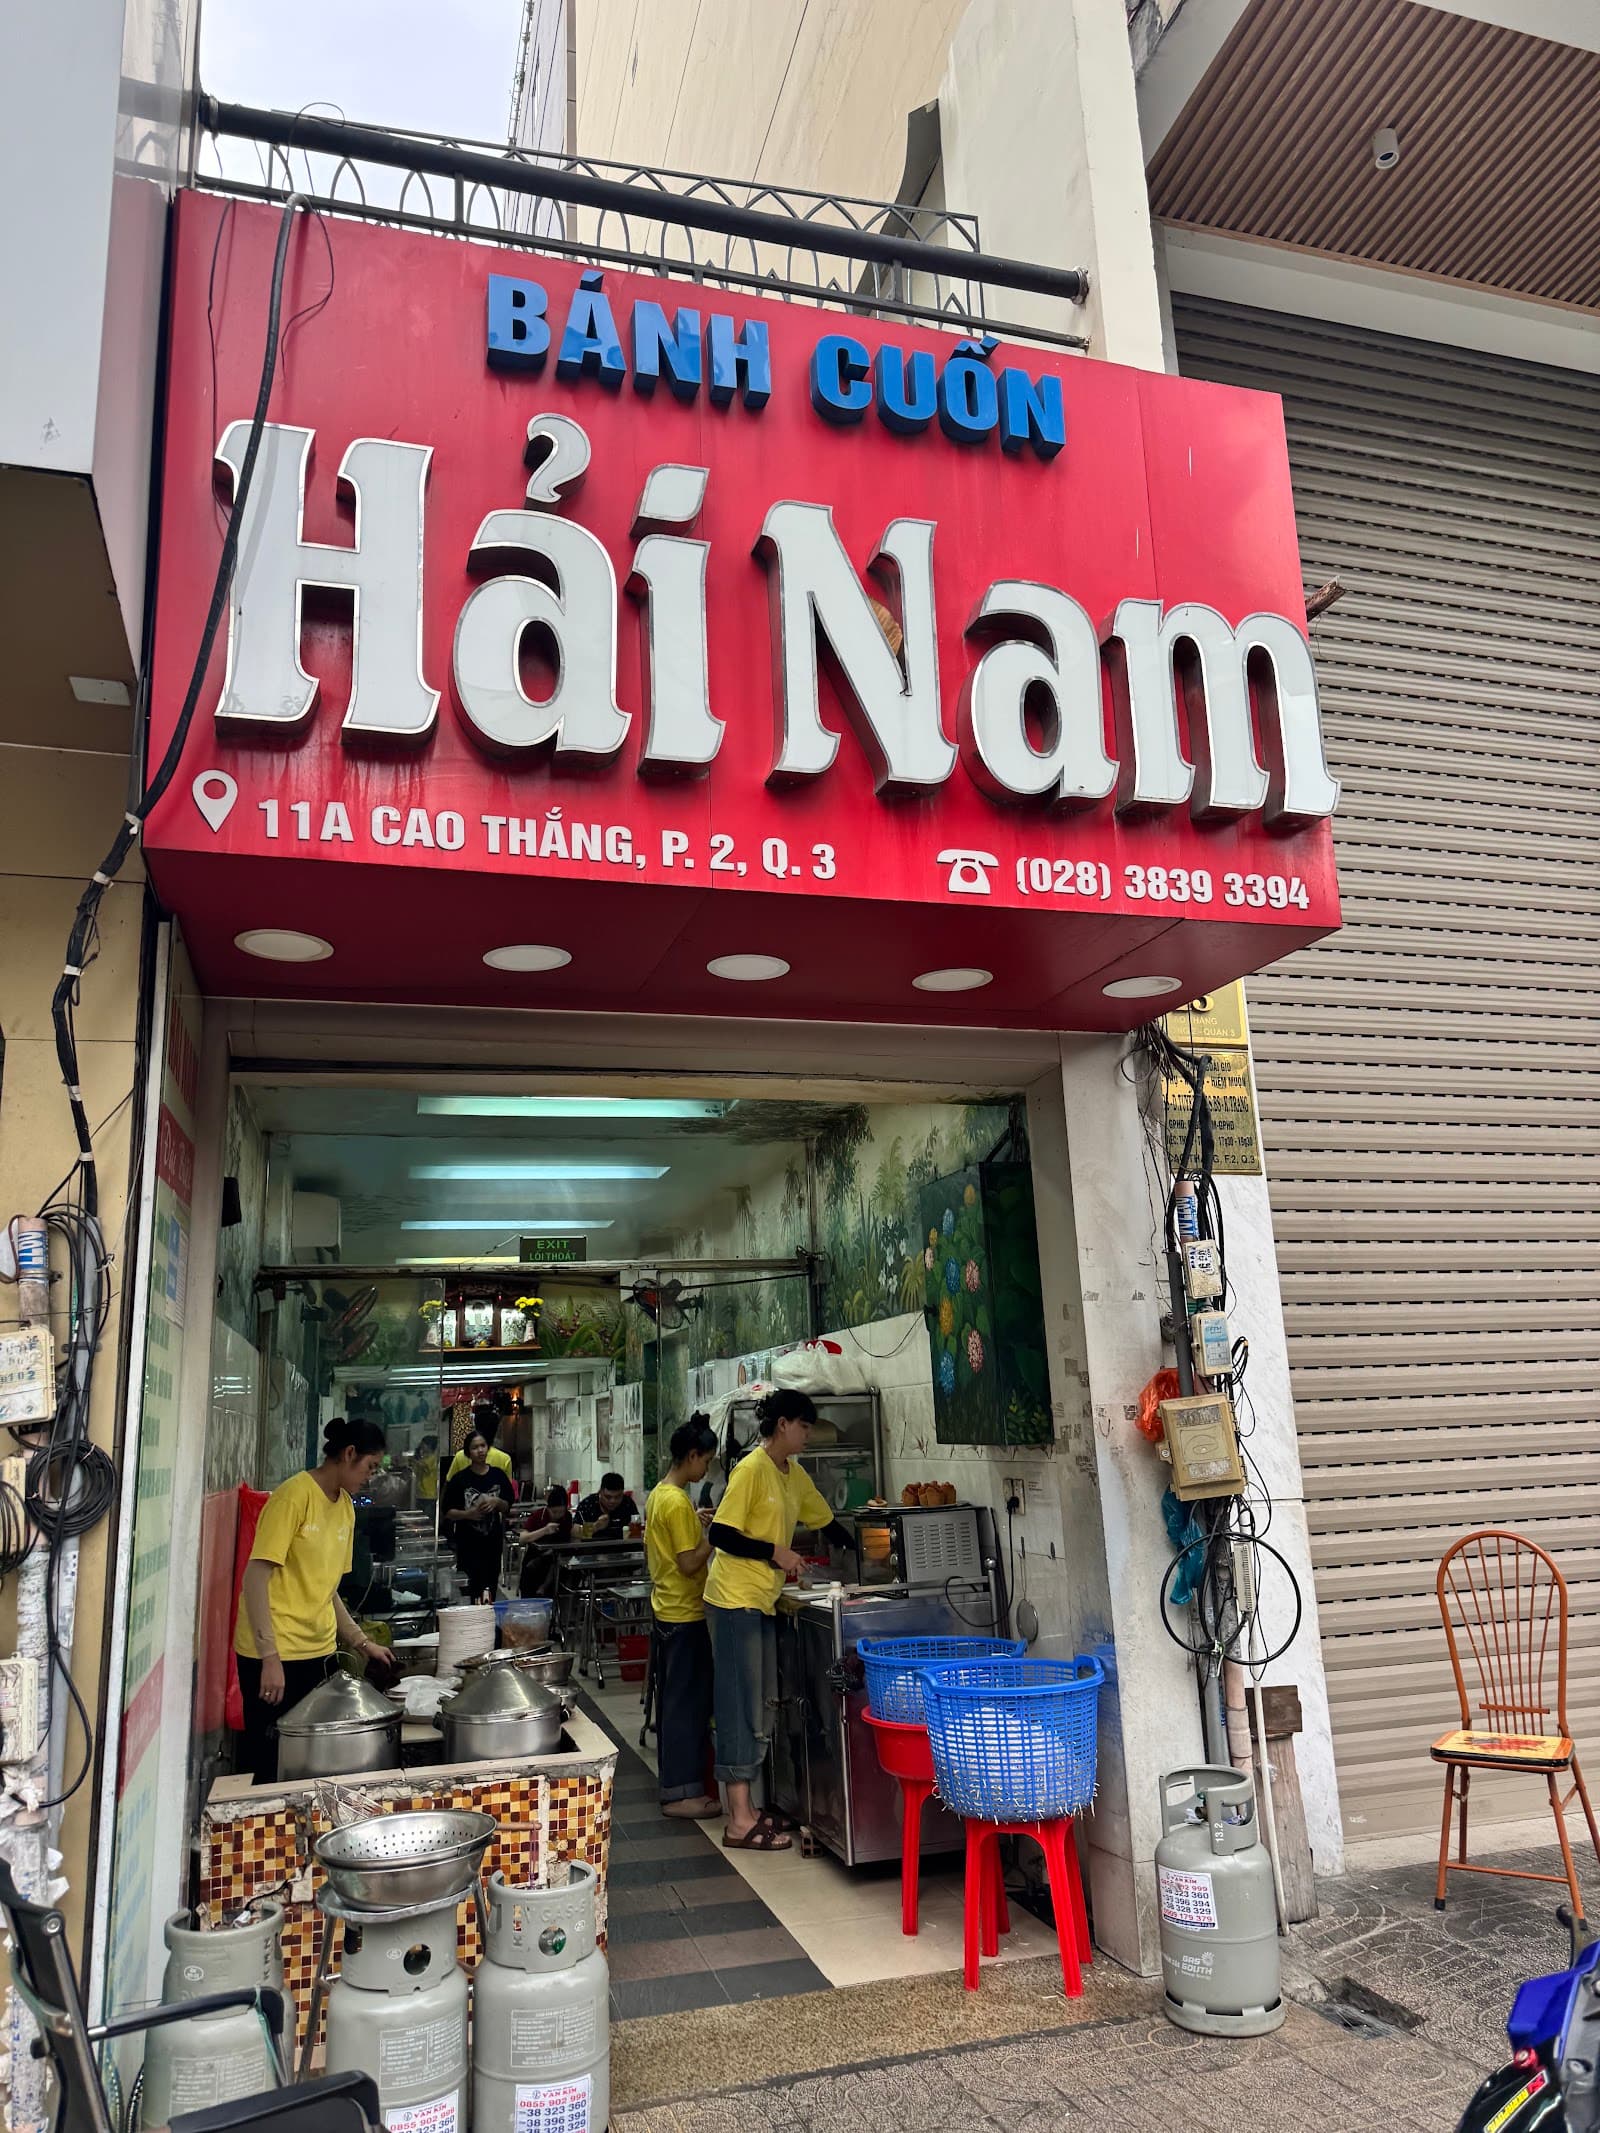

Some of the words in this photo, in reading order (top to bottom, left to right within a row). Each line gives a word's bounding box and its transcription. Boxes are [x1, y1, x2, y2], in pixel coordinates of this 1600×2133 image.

[487, 270, 773, 405] BÁNH
[811, 336, 1066, 454] CUỐN
[214, 413, 724, 767] Hải
[754, 500, 1340, 819] Nam
[258, 798, 354, 843] 11A
[370, 805, 465, 851] CAO
[481, 806, 646, 871] THẮNG,
[661, 830, 694, 869] P.
[710, 834, 747, 876] 2,
[762, 837, 801, 879] Q.
[812, 843, 837, 880] 3
[1016, 856, 1111, 899] (028)
[1123, 864, 1213, 903] 3839
[1223, 872, 1310, 909] 3394
[537, 1240, 569, 1249] EXIT
[1214, 1822, 1224, 1843] 13.2
[1191, 1891, 1209, 1899] 360
[1193, 1907, 1211, 1915] 329
[1182, 1954, 1201, 1966] GAS
[1181, 1962, 1213, 1976] SOUTH
[519, 2100, 545, 2108] 0855
[548, 2097, 567, 2107] 902
[527, 2108, 541, 2117] 38
[544, 2105, 566, 2116] 323
[568, 2099, 587, 2112] 360
[390, 2121, 417, 2132] 0855
[420, 2115, 438, 2127] 902
[438, 2114, 455, 2129] 360
[526, 2119, 541, 2128] 38
[544, 2116, 565, 2127] 396
[568, 2109, 586, 2123] 394
[568, 2119, 586, 2132] 329
